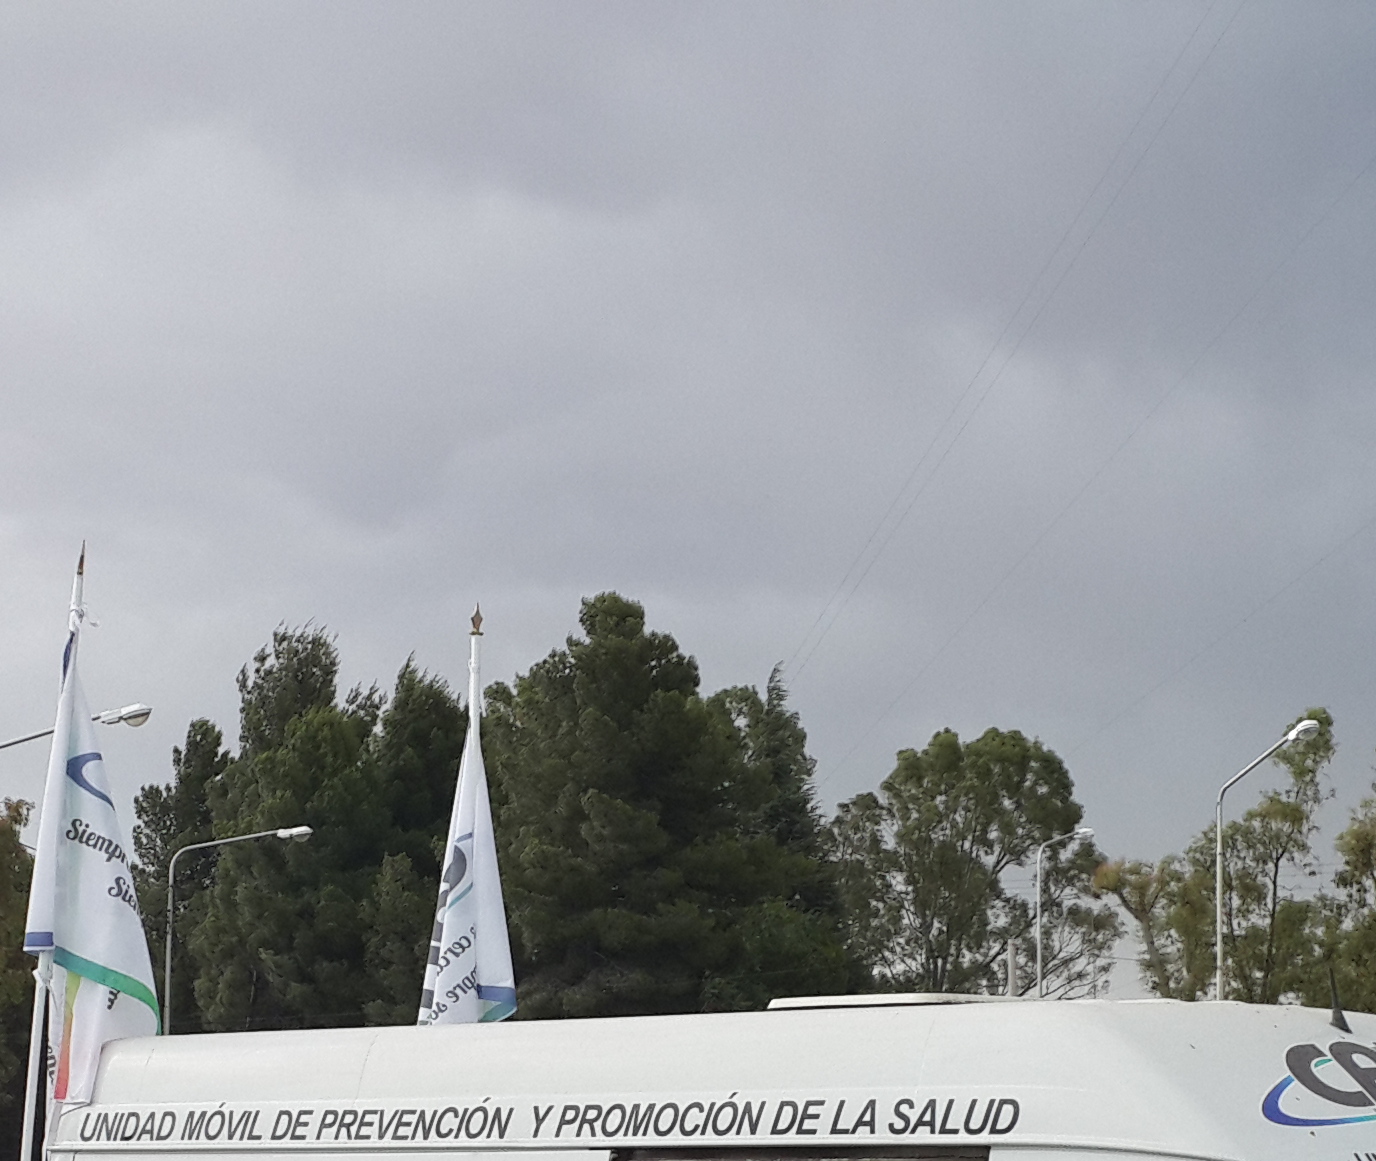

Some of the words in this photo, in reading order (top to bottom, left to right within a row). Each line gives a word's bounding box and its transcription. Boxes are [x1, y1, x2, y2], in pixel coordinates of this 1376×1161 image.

[80, 1111, 176, 1141] UNIDAD
[181, 1101, 263, 1141] MÓVIL
[270, 1109, 313, 1140] DE
[315, 1097, 515, 1140] PREVENCIÓN
[533, 1105, 553, 1138] Y
[554, 1092, 766, 1138] PROMOCIÓN
[770, 1100, 825, 1136] DE
[829, 1099, 876, 1135] LA
[888, 1098, 1020, 1135] SALUD
